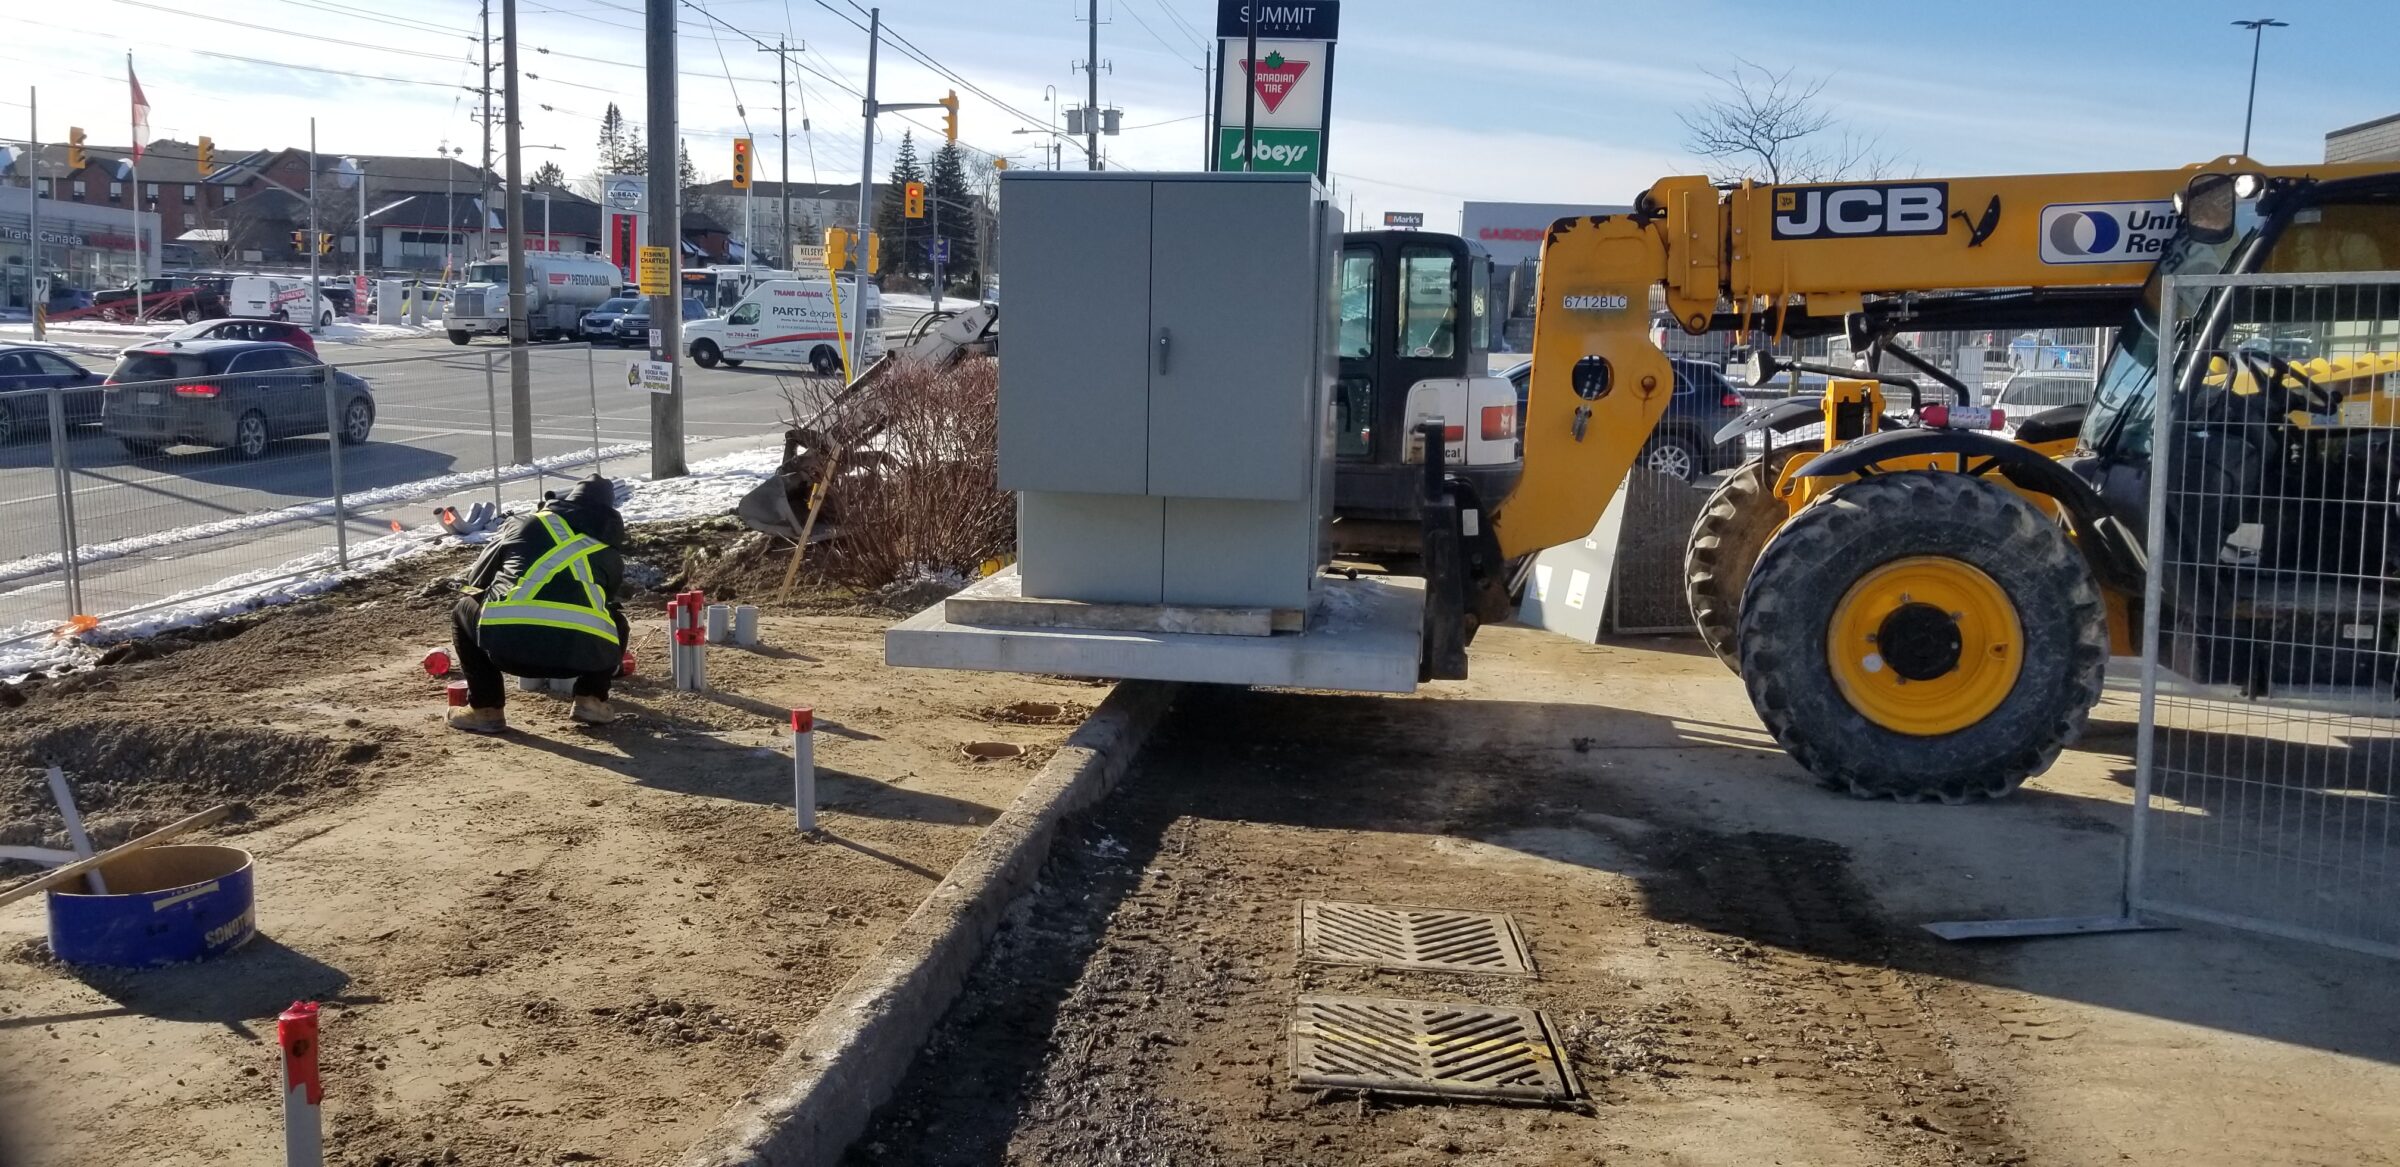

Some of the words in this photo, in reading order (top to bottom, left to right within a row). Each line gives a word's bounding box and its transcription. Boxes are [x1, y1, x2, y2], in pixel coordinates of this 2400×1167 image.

[1240, 6, 1316, 24] SUMMIT
[1255, 73, 1295, 83] ANADIAN
[1264, 84, 1282, 93] TIRE
[1776, 187, 1944, 236] JCB
[1393, 215, 1420, 224] Mark's
[39, 231, 83, 246] Canada
[773, 289, 795, 297] TRANS
[796, 290, 823, 298] CANADA
[1564, 296, 1627, 308] 6712BLC
[772, 306, 807, 317] PARTS
[809, 310, 848, 319] express
